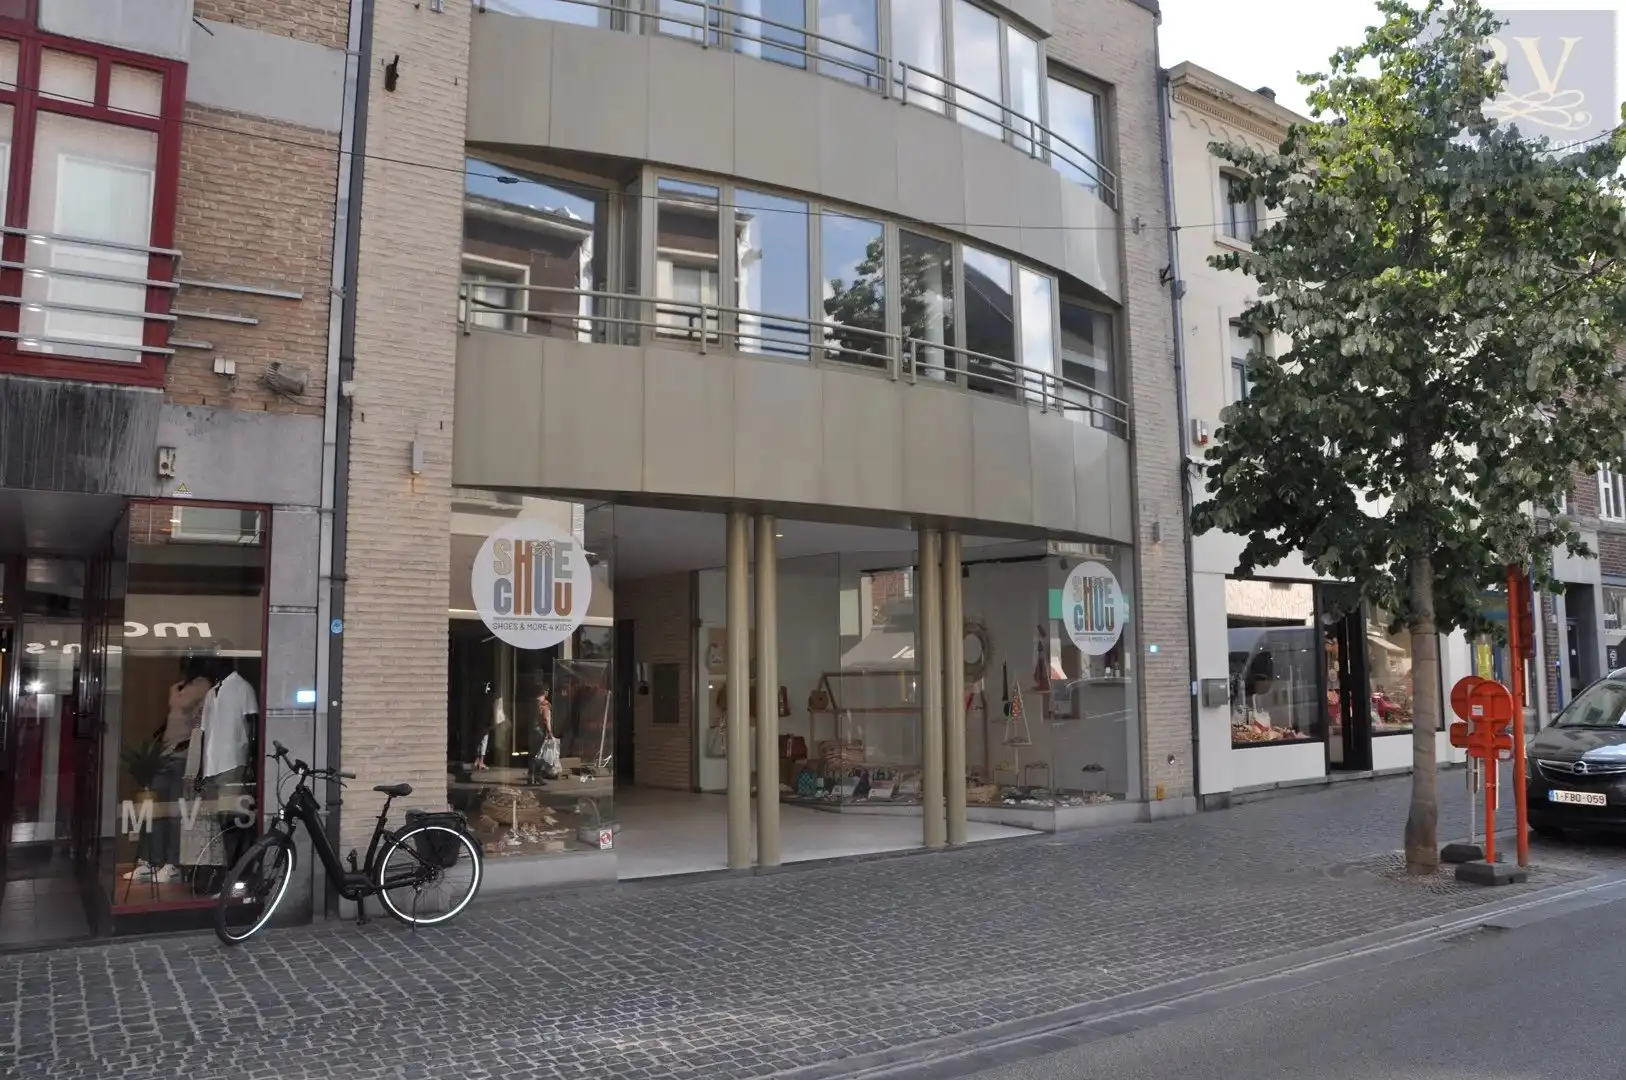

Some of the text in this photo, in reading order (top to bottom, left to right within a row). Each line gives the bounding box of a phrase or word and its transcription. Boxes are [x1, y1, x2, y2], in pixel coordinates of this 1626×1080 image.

[492, 622, 518, 631] SHOES
[519, 622, 525, 630] &
[526, 623, 547, 631] MORE
[554, 624, 572, 632] KIDS
